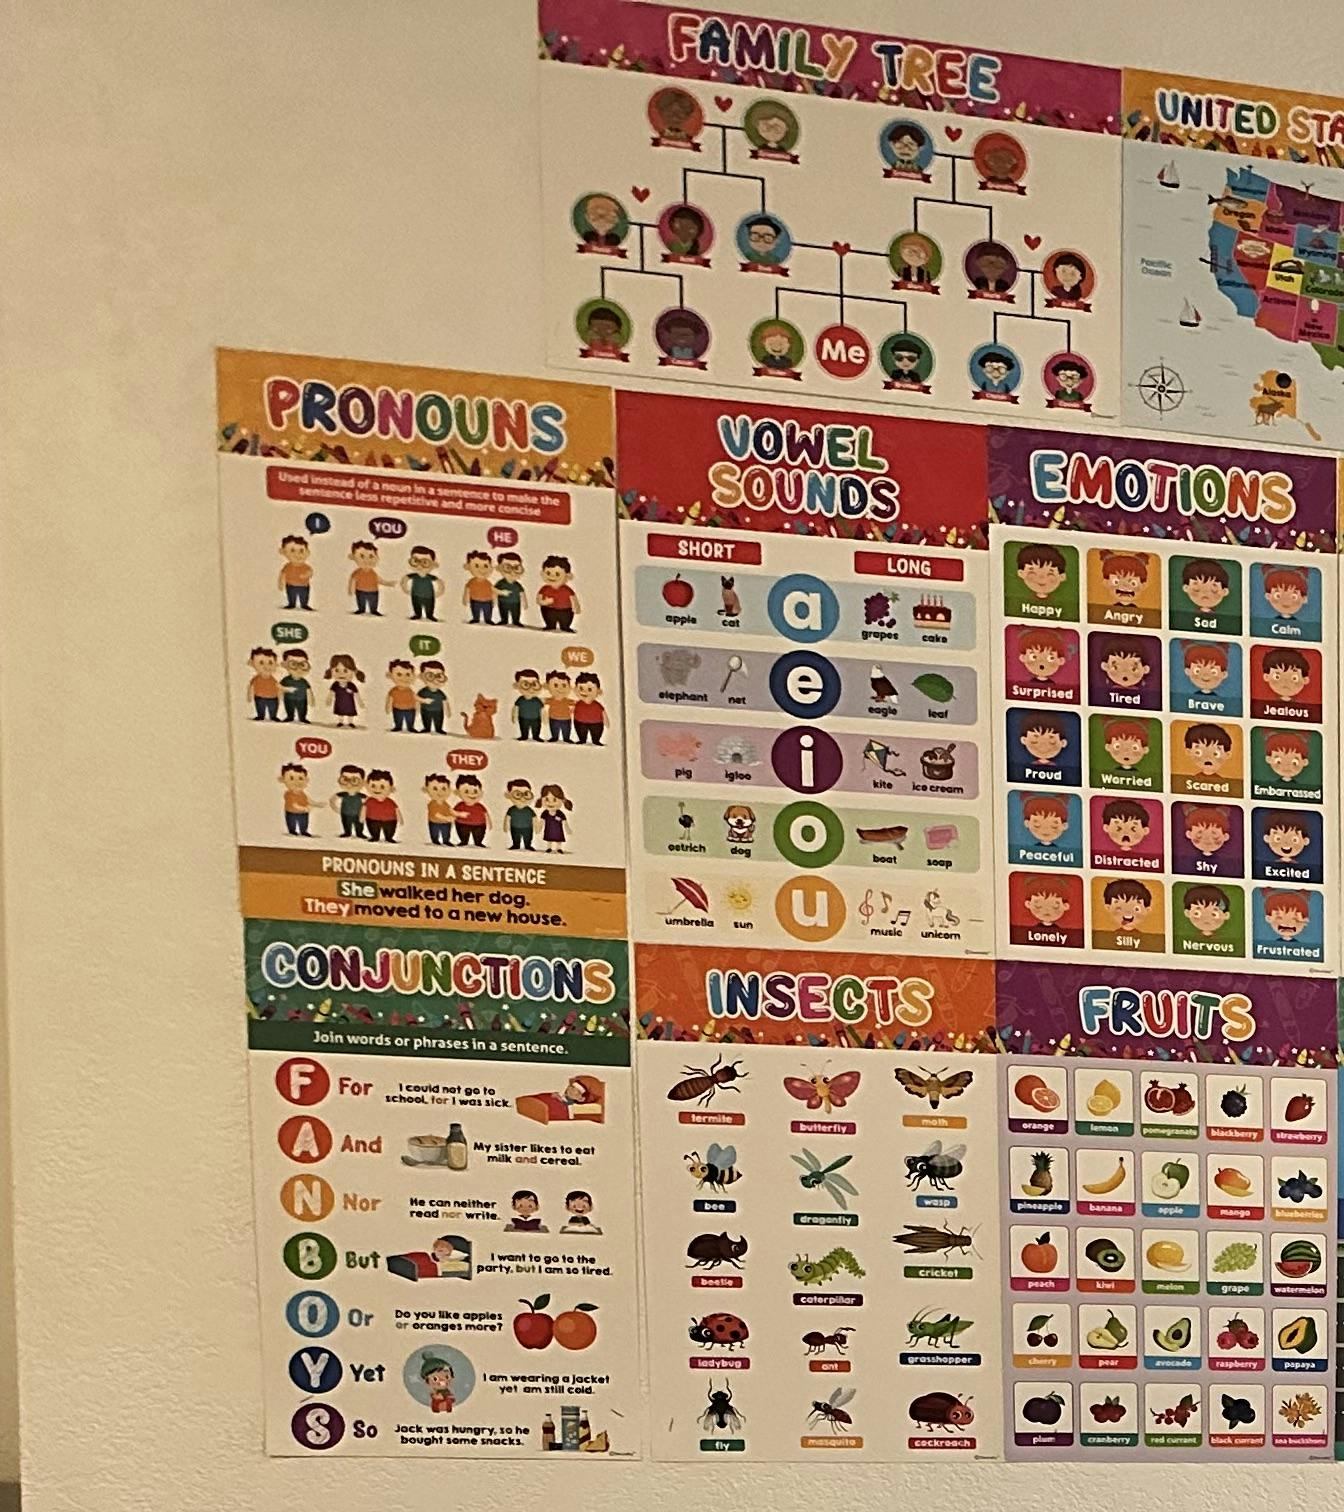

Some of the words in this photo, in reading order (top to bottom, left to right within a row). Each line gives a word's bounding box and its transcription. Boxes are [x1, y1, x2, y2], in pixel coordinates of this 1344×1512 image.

[667, 12, 856, 82] FAMILY
[872, 37, 1002, 103] TREE
[1154, 88, 1279, 138] UNITED
[821, 340, 865, 365] Me
[264, 376, 567, 455] PRONOUNS
[718, 414, 890, 473] VOWEL
[708, 462, 901, 522] SOUNDS
[1029, 449, 1296, 524] EMOTIONS
[678, 539, 736, 560] SHORT
[888, 558, 932, 577] LONG
[783, 591, 822, 632] a
[1021, 603, 1062, 618] Happy
[1104, 609, 1144, 624] Angry
[276, 627, 303, 639] SHE
[1194, 617, 1217, 629] Sad
[787, 666, 824, 705] e
[1011, 685, 1074, 700] Surprised
[452, 753, 484, 766] THEY
[800, 734, 815, 787] i
[790, 815, 827, 853] o
[731, 845, 752, 858] dog
[322, 856, 415, 878] PRONOUNS
[422, 863, 437, 878] IN
[446, 864, 457, 879] A
[463, 866, 546, 885] SENTENCE
[1265, 866, 1310, 880] Excited
[341, 882, 376, 898] She
[379, 885, 450, 902] walked
[453, 887, 486, 904] her
[489, 889, 531, 909] dog.
[305, 900, 352, 919] They
[354, 901, 422, 919] moved
[425, 904, 444, 919] to
[448, 908, 461, 920] a
[465, 908, 503, 922] new
[507, 907, 568, 927] house.
[792, 889, 829, 927] u
[262, 941, 618, 1005] CONJUNCTIONS
[705, 967, 935, 1027] INSECTS
[1079, 985, 1256, 1041] FRUITS
[313, 1031, 344, 1047] Join
[347, 1033, 393, 1047] words
[395, 1036, 411, 1047] or
[414, 1034, 470, 1051] phrases
[473, 1038, 487, 1051] in
[489, 1041, 498, 1051] a
[501, 1040, 569, 1055] sentence.
[339, 1078, 374, 1097] For
[799, 1122, 848, 1133] butterfly
[341, 1136, 382, 1155] And
[705, 1201, 725, 1211] bee
[345, 1250, 381, 1269] But
[907, 1354, 973, 1365] grasshopper
[350, 1364, 386, 1382] Yet
[353, 1420, 378, 1438] So
